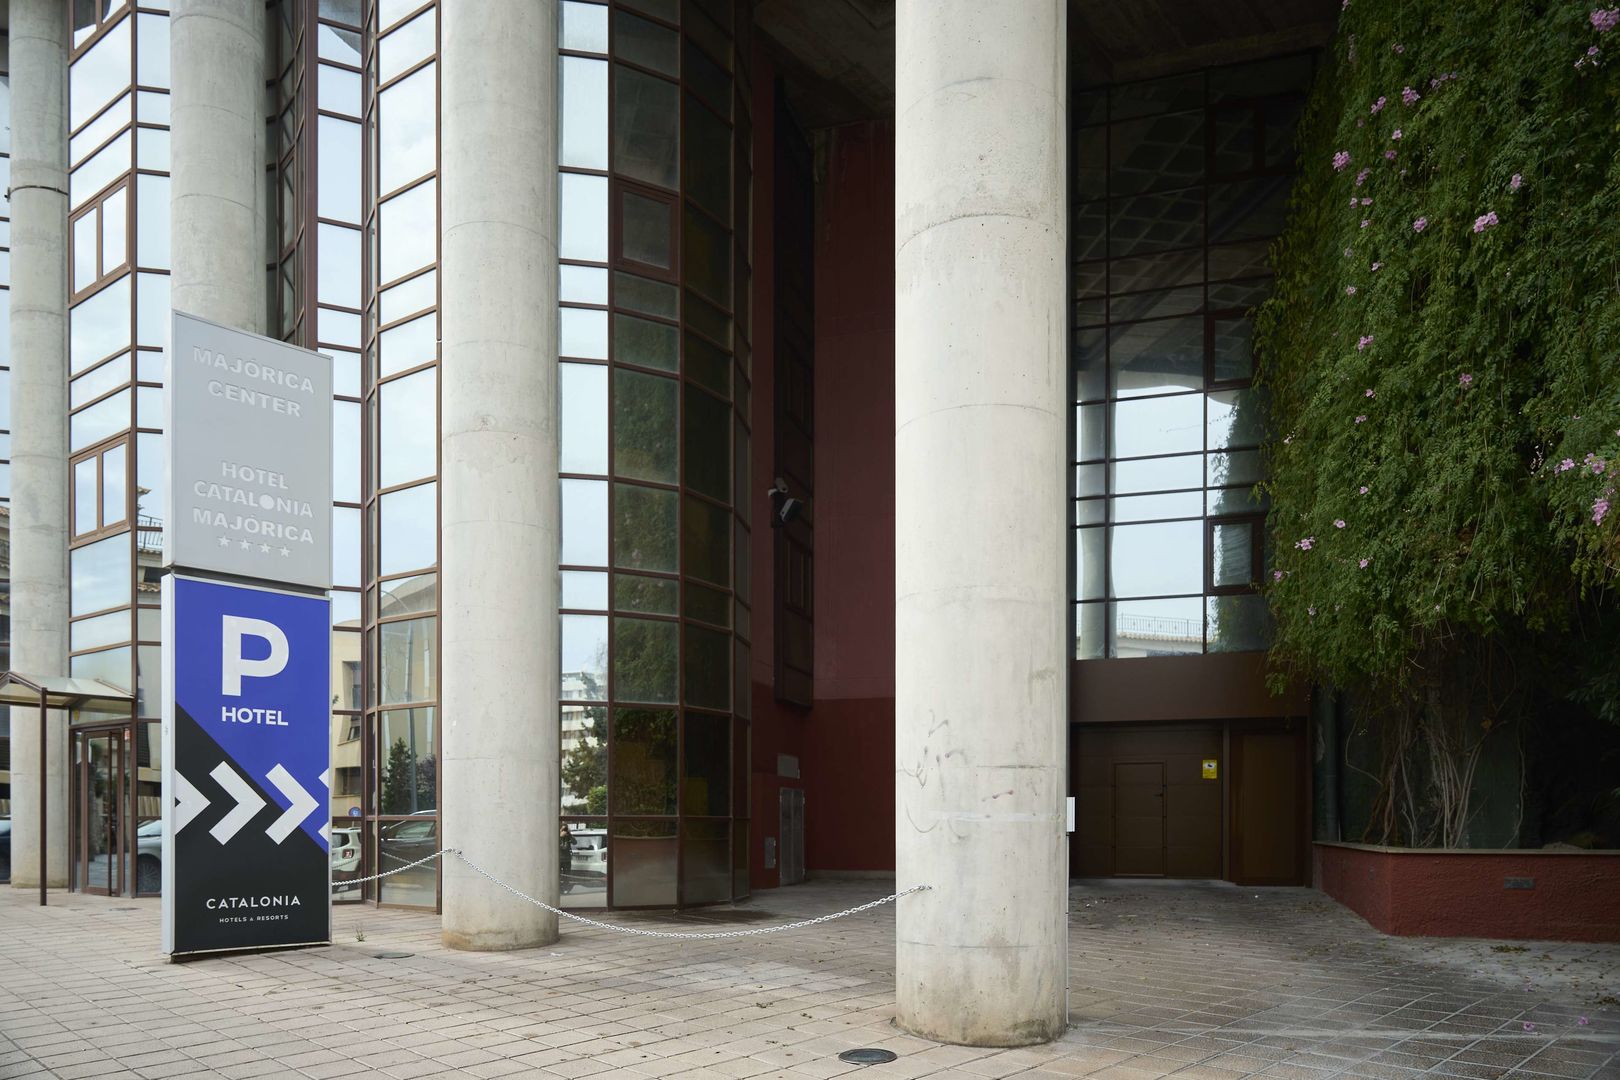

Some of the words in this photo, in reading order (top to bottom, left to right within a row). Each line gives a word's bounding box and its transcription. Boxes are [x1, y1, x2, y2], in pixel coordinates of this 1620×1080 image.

[208, 380, 301, 417] CENTER
[221, 461, 289, 490] HOTEL
[193, 481, 313, 518] CATALONIA
[222, 614, 290, 697] P
[221, 706, 289, 726] HOTEL
[206, 895, 301, 909] CATALONIA
